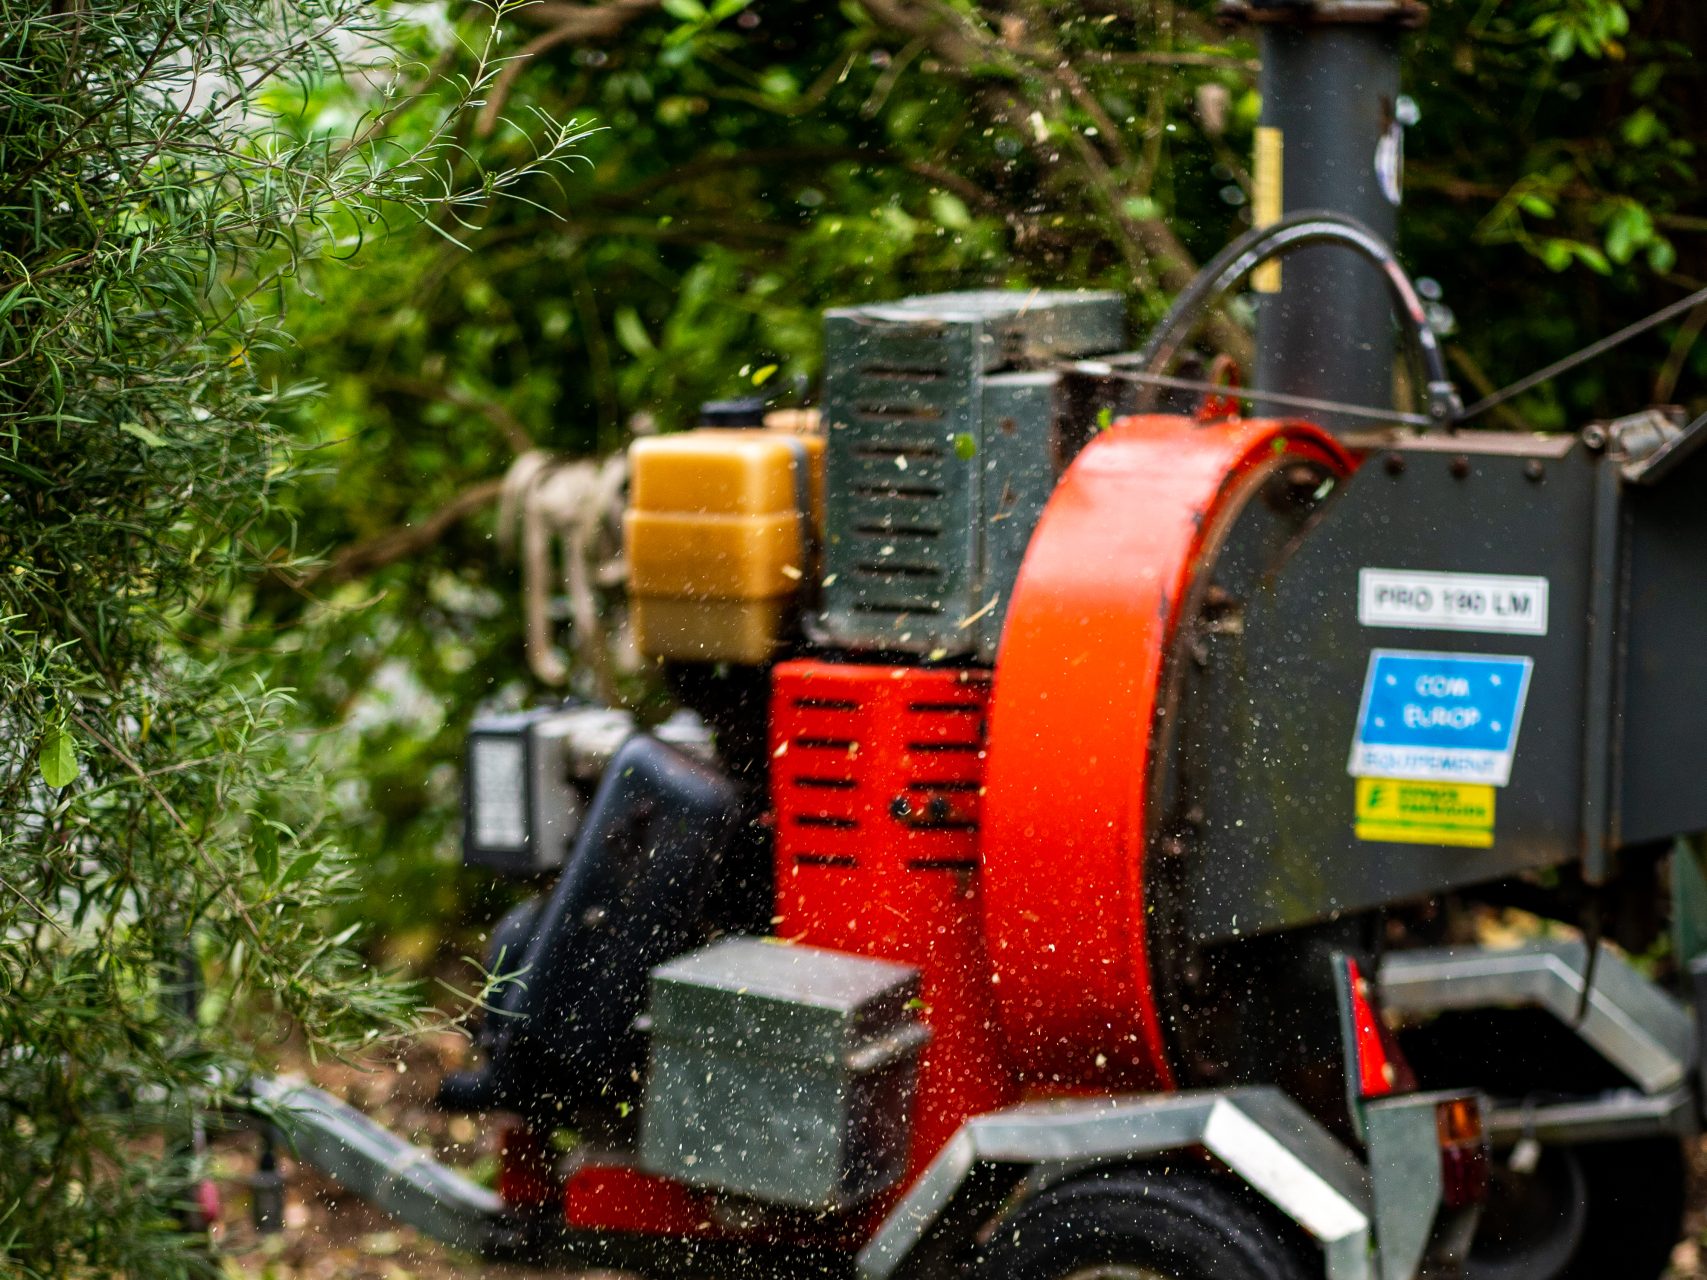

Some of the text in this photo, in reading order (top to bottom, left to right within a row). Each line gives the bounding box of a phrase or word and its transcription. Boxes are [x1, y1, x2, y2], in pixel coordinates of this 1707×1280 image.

[1374, 584, 1434, 613] PRO
[1492, 591, 1533, 617] LM
[1415, 675, 1470, 698] COM
[1403, 703, 1482, 730] EUROP
